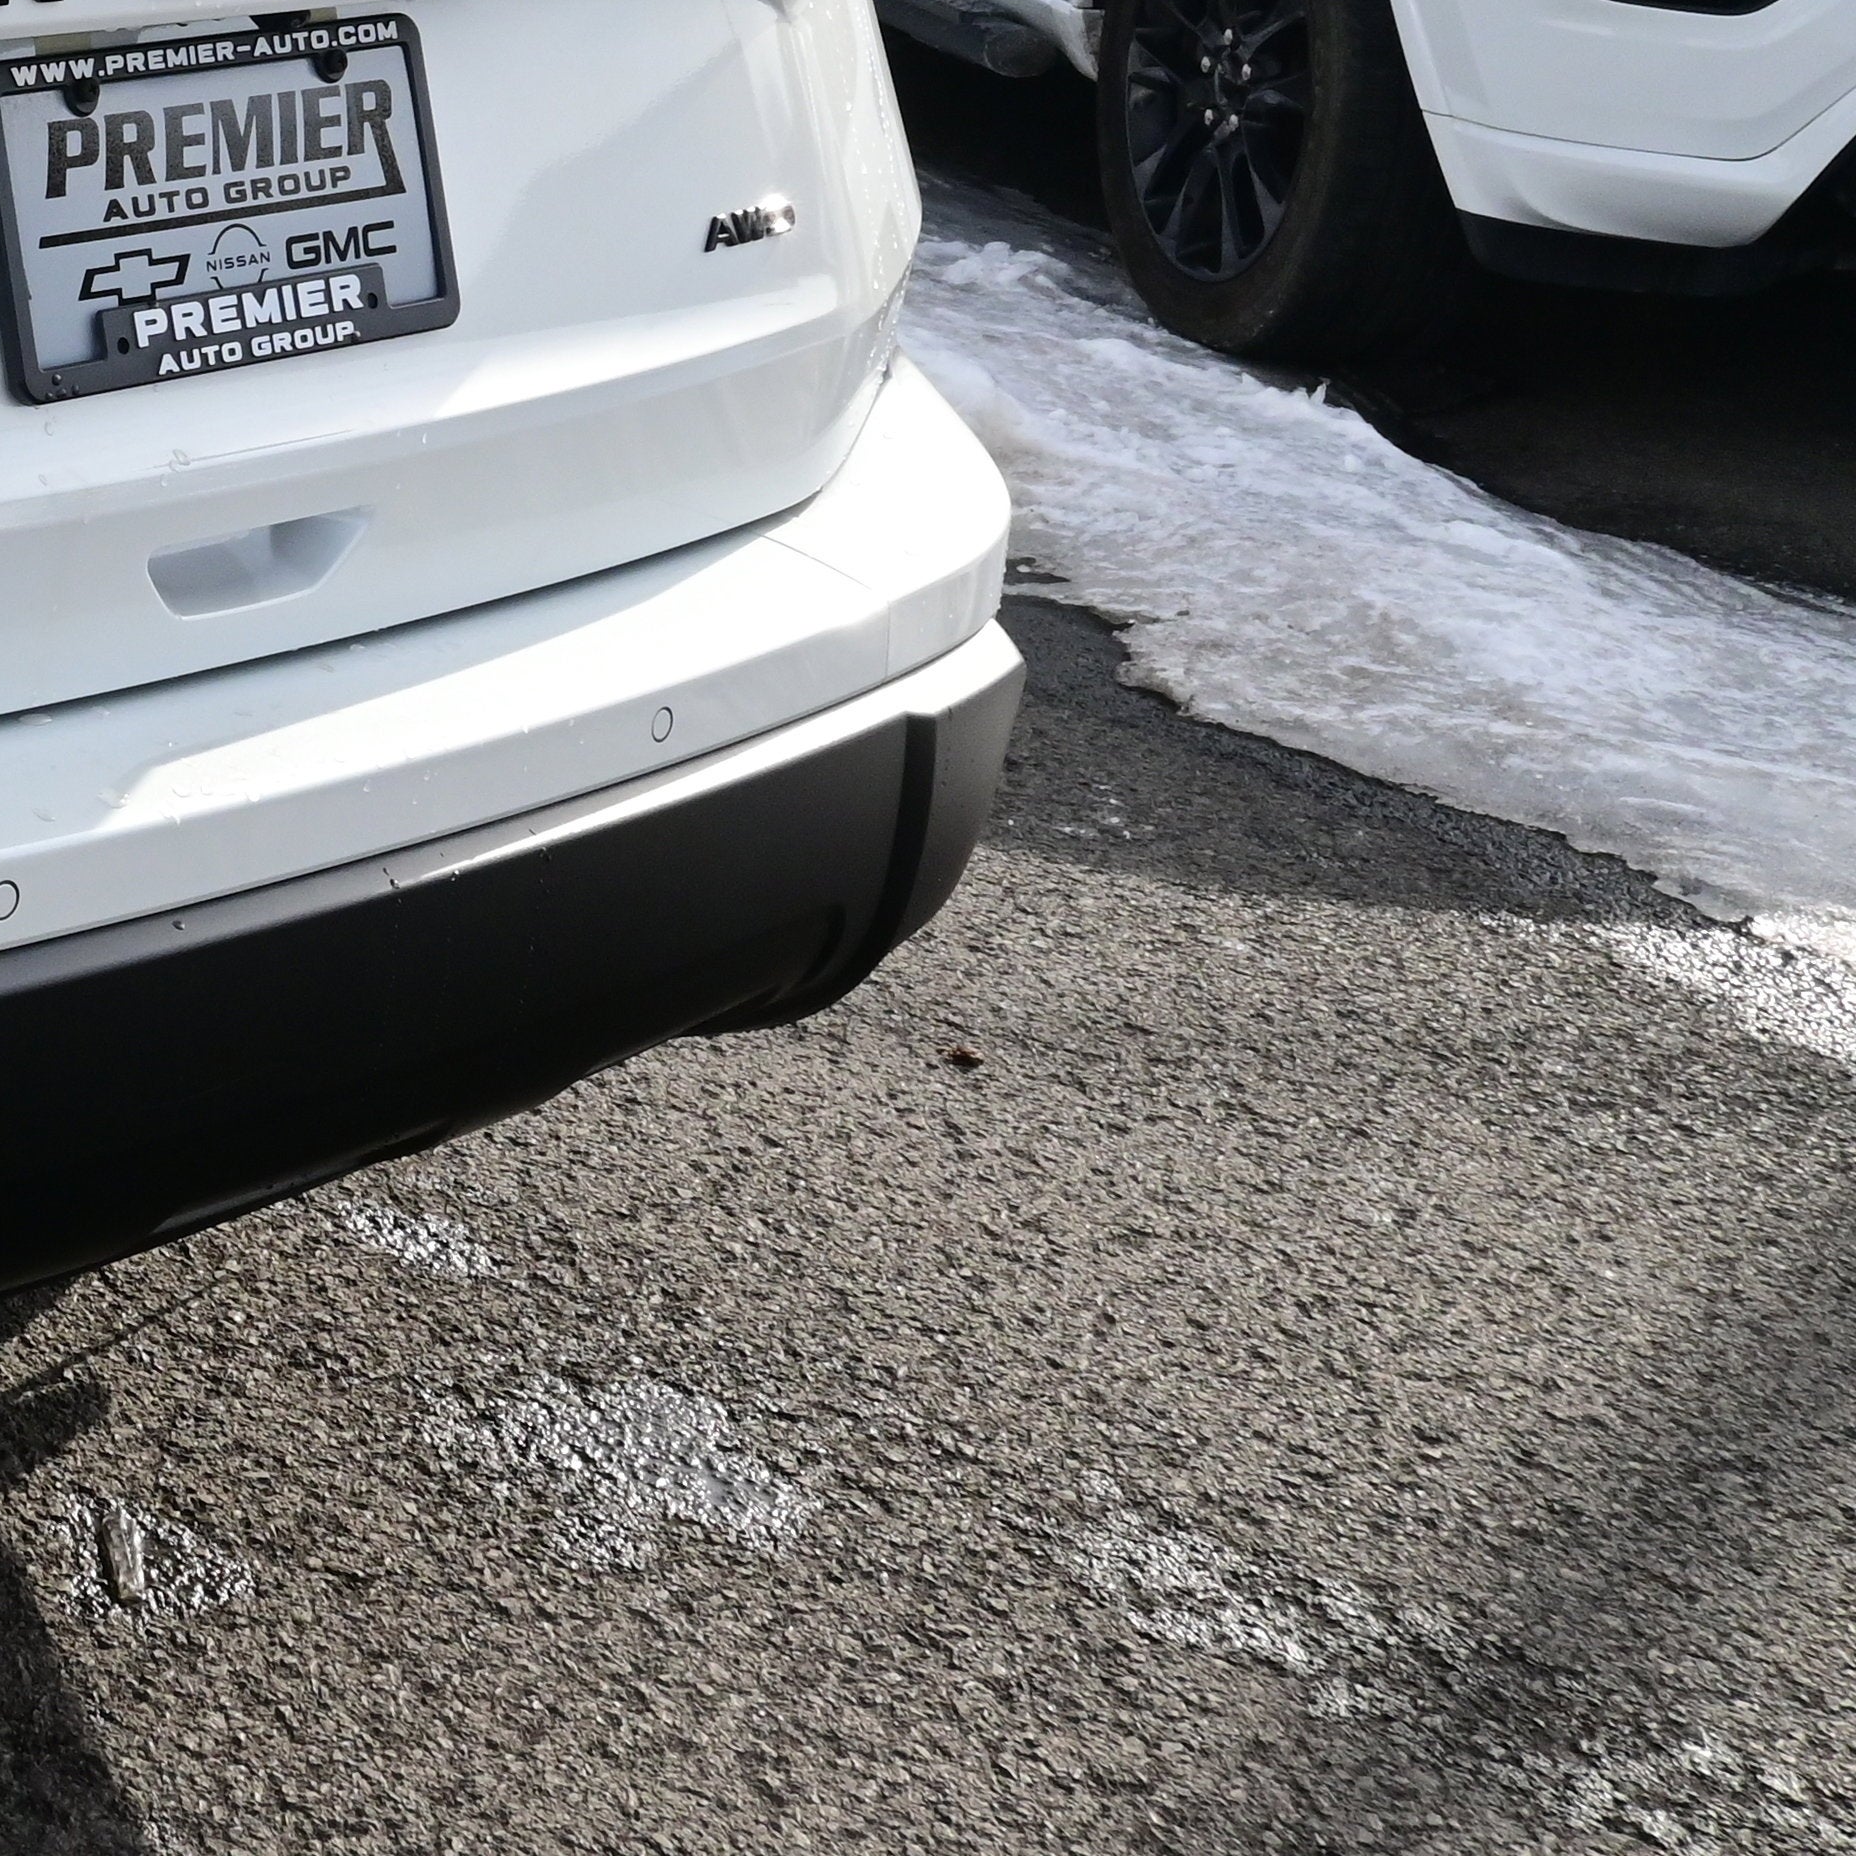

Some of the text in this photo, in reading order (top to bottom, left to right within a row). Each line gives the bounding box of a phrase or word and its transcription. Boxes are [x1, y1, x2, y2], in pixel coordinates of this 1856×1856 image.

[10, 20, 399, 87] WWW.PREMIER-AUTO.COM
[45, 78, 406, 200] PREMIER
[103, 165, 351, 222] AUTO GROUP
[205, 251, 271, 273] NISSAN
[285, 220, 397, 270] GMC
[133, 273, 364, 348] PREMIER
[158, 320, 356, 376] AUTO GROUP
